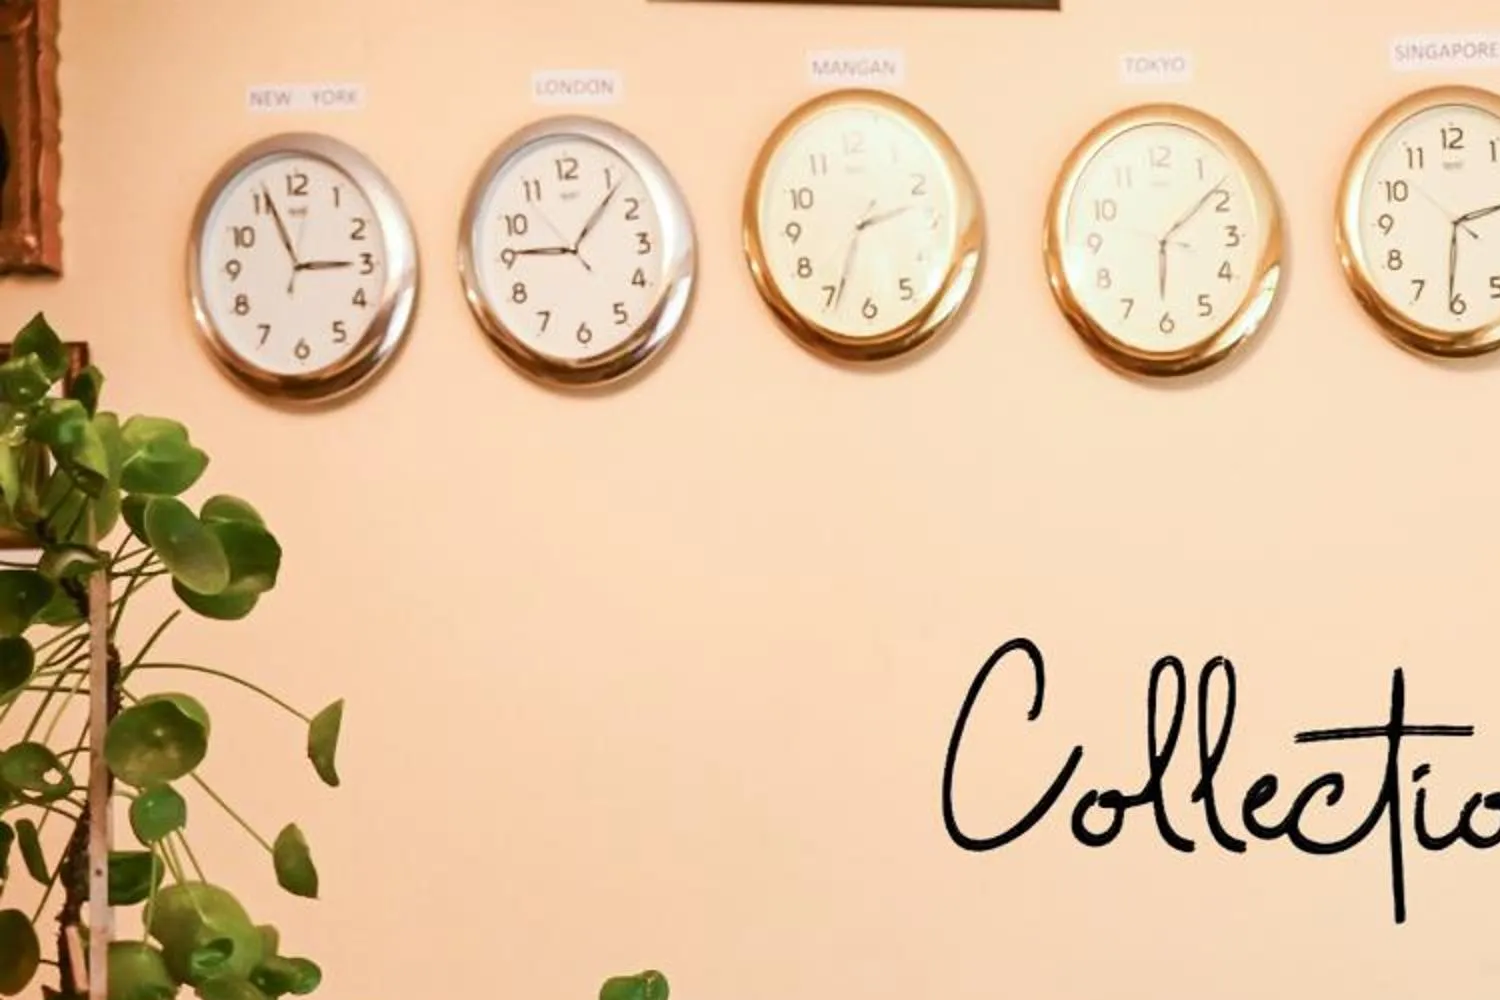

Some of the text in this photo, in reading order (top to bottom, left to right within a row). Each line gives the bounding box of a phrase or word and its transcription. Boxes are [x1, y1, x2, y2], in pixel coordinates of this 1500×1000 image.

[1395, 41, 1499, 61] SINGAPORE
[812, 58, 896, 76] MANGAN
[1125, 57, 1186, 72] TOKYO
[250, 89, 358, 107] NEW YORK
[536, 78, 613, 96] LONDON
[1441, 127, 1464, 149] 12
[1150, 146, 1171, 167] 12
[1407, 147, 1424, 169] 11
[1489, 140, 1496, 162] 1
[556, 157, 579, 180] 12
[810, 154, 827, 176] 11
[1197, 157, 1203, 180] 1
[286, 174, 309, 196] 12
[604, 168, 611, 189] 1
[911, 174, 927, 195] 2
[1116, 166, 1132, 188] 11
[333, 186, 340, 208] 1
[524, 180, 541, 201] 11
[791, 187, 814, 210] 10
[1215, 189, 1230, 212] 2
[1385, 180, 1409, 202] 10
[624, 197, 639, 220] 2
[1095, 199, 1117, 221] 10
[350, 218, 366, 241] 2
[506, 213, 528, 236] 10
[785, 222, 801, 244] 9
[1378, 214, 1394, 235] 9
[233, 225, 255, 248] 10
[636, 232, 651, 254] 3
[1087, 233, 1103, 255] 9
[1225, 225, 1240, 247] 3
[225, 259, 241, 281] 9
[359, 253, 374, 274] 3
[500, 248, 516, 270] 9
[797, 257, 812, 278] 8
[1387, 249, 1403, 271] 8
[632, 268, 646, 287] 4
[1097, 268, 1112, 289] 8
[1218, 261, 1232, 282] 4
[352, 287, 367, 308] 4
[512, 282, 527, 303] 8
[822, 285, 836, 307] 7
[899, 277, 913, 301] 5
[1411, 279, 1425, 301] 7
[235, 294, 250, 316] 8
[613, 302, 628, 324] 5
[862, 297, 878, 319] 6
[1120, 298, 1134, 319] 7
[1198, 294, 1213, 316] 5
[1450, 294, 1467, 315] 6
[537, 310, 550, 331] 7
[1159, 312, 1175, 334] 6
[257, 324, 271, 345] 7
[332, 321, 347, 343] 5
[577, 322, 592, 344] 6
[294, 338, 310, 359] 6
